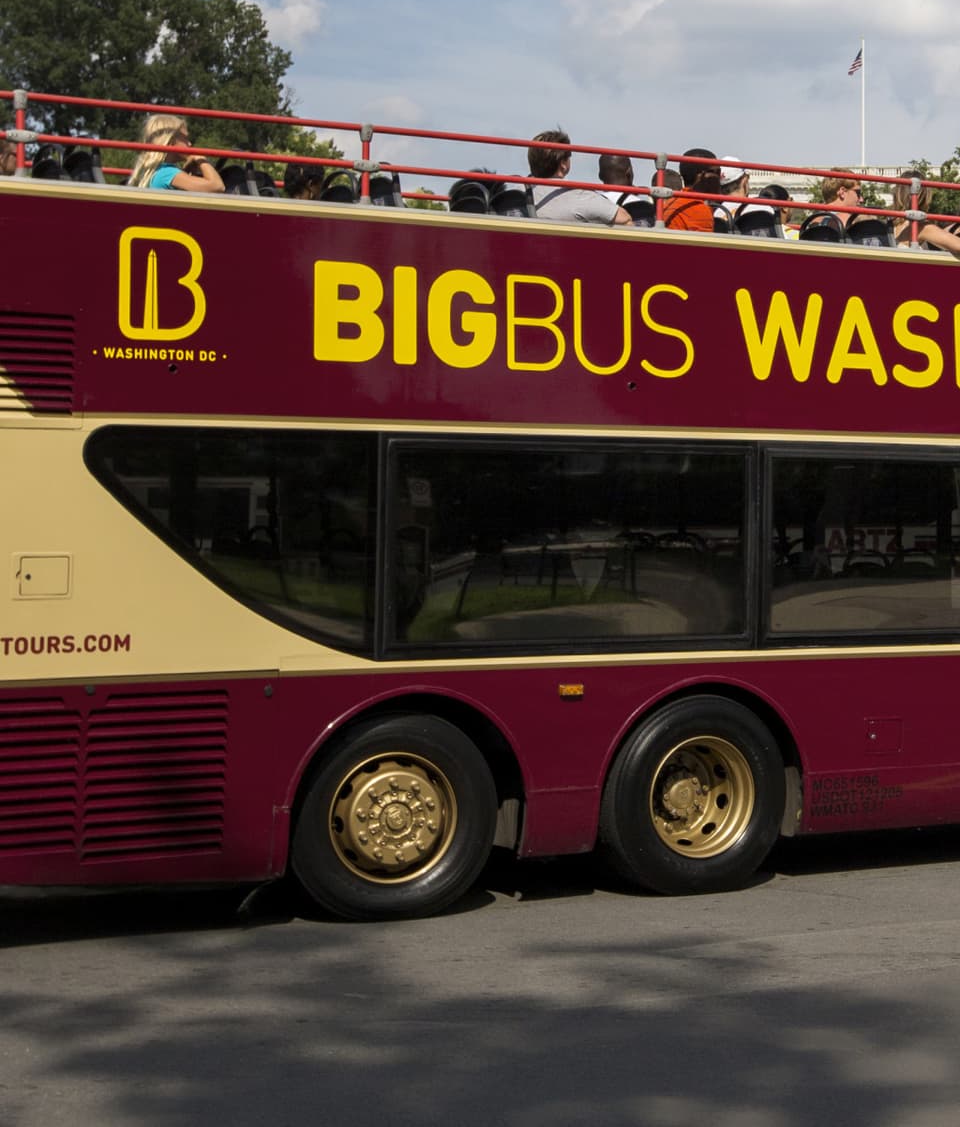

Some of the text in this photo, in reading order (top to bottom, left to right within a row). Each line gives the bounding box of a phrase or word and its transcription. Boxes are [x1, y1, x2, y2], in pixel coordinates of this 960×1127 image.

[103, 347, 217, 362] WASHINGTON DC
[0, 634, 131, 655] TOURS.COM
